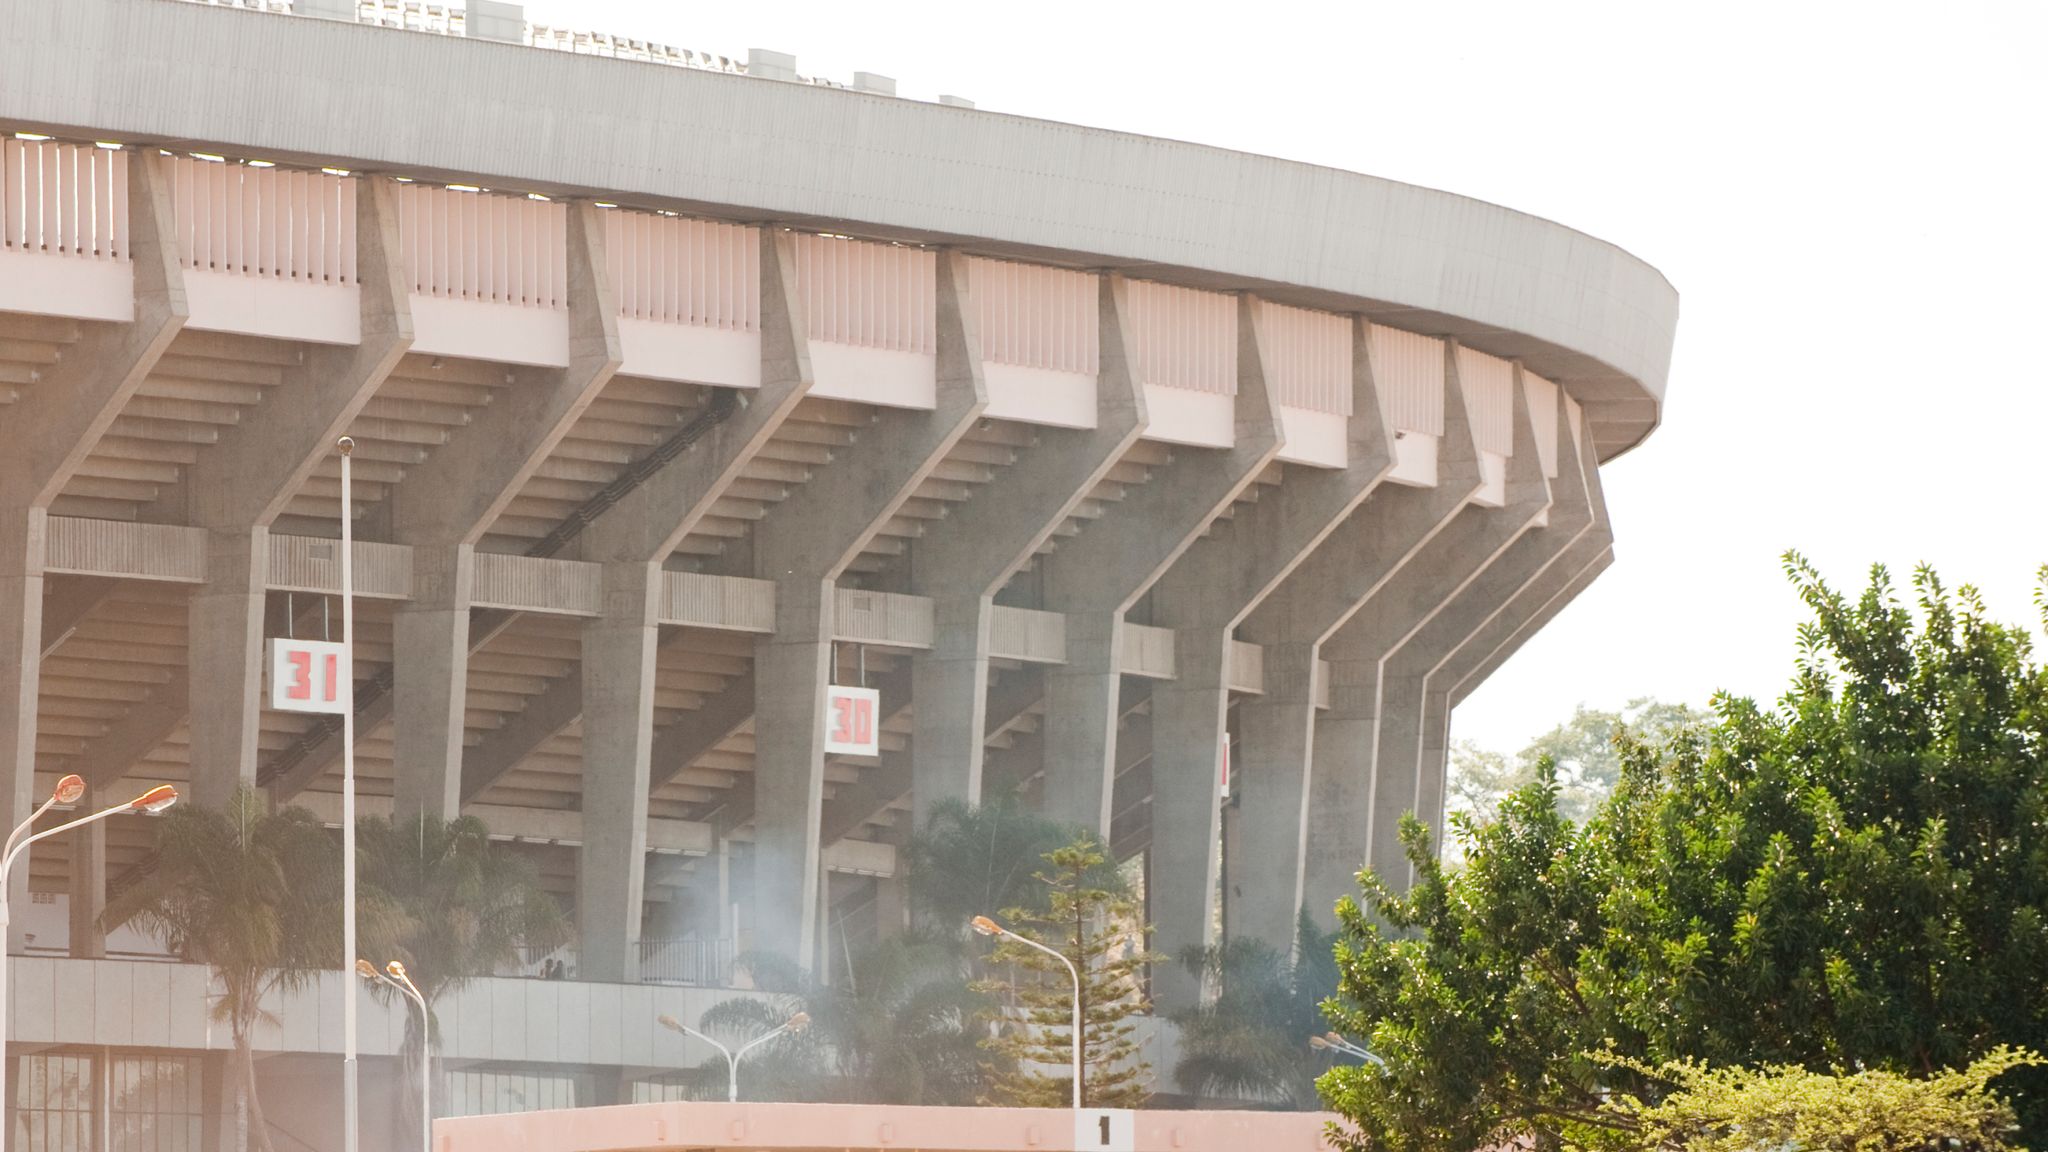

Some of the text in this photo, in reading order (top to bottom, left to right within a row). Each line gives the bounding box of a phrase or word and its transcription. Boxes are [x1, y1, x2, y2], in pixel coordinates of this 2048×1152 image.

[287, 651, 337, 701] 31
[832, 697, 871, 744] 30
[1099, 1116, 1110, 1145] 1
